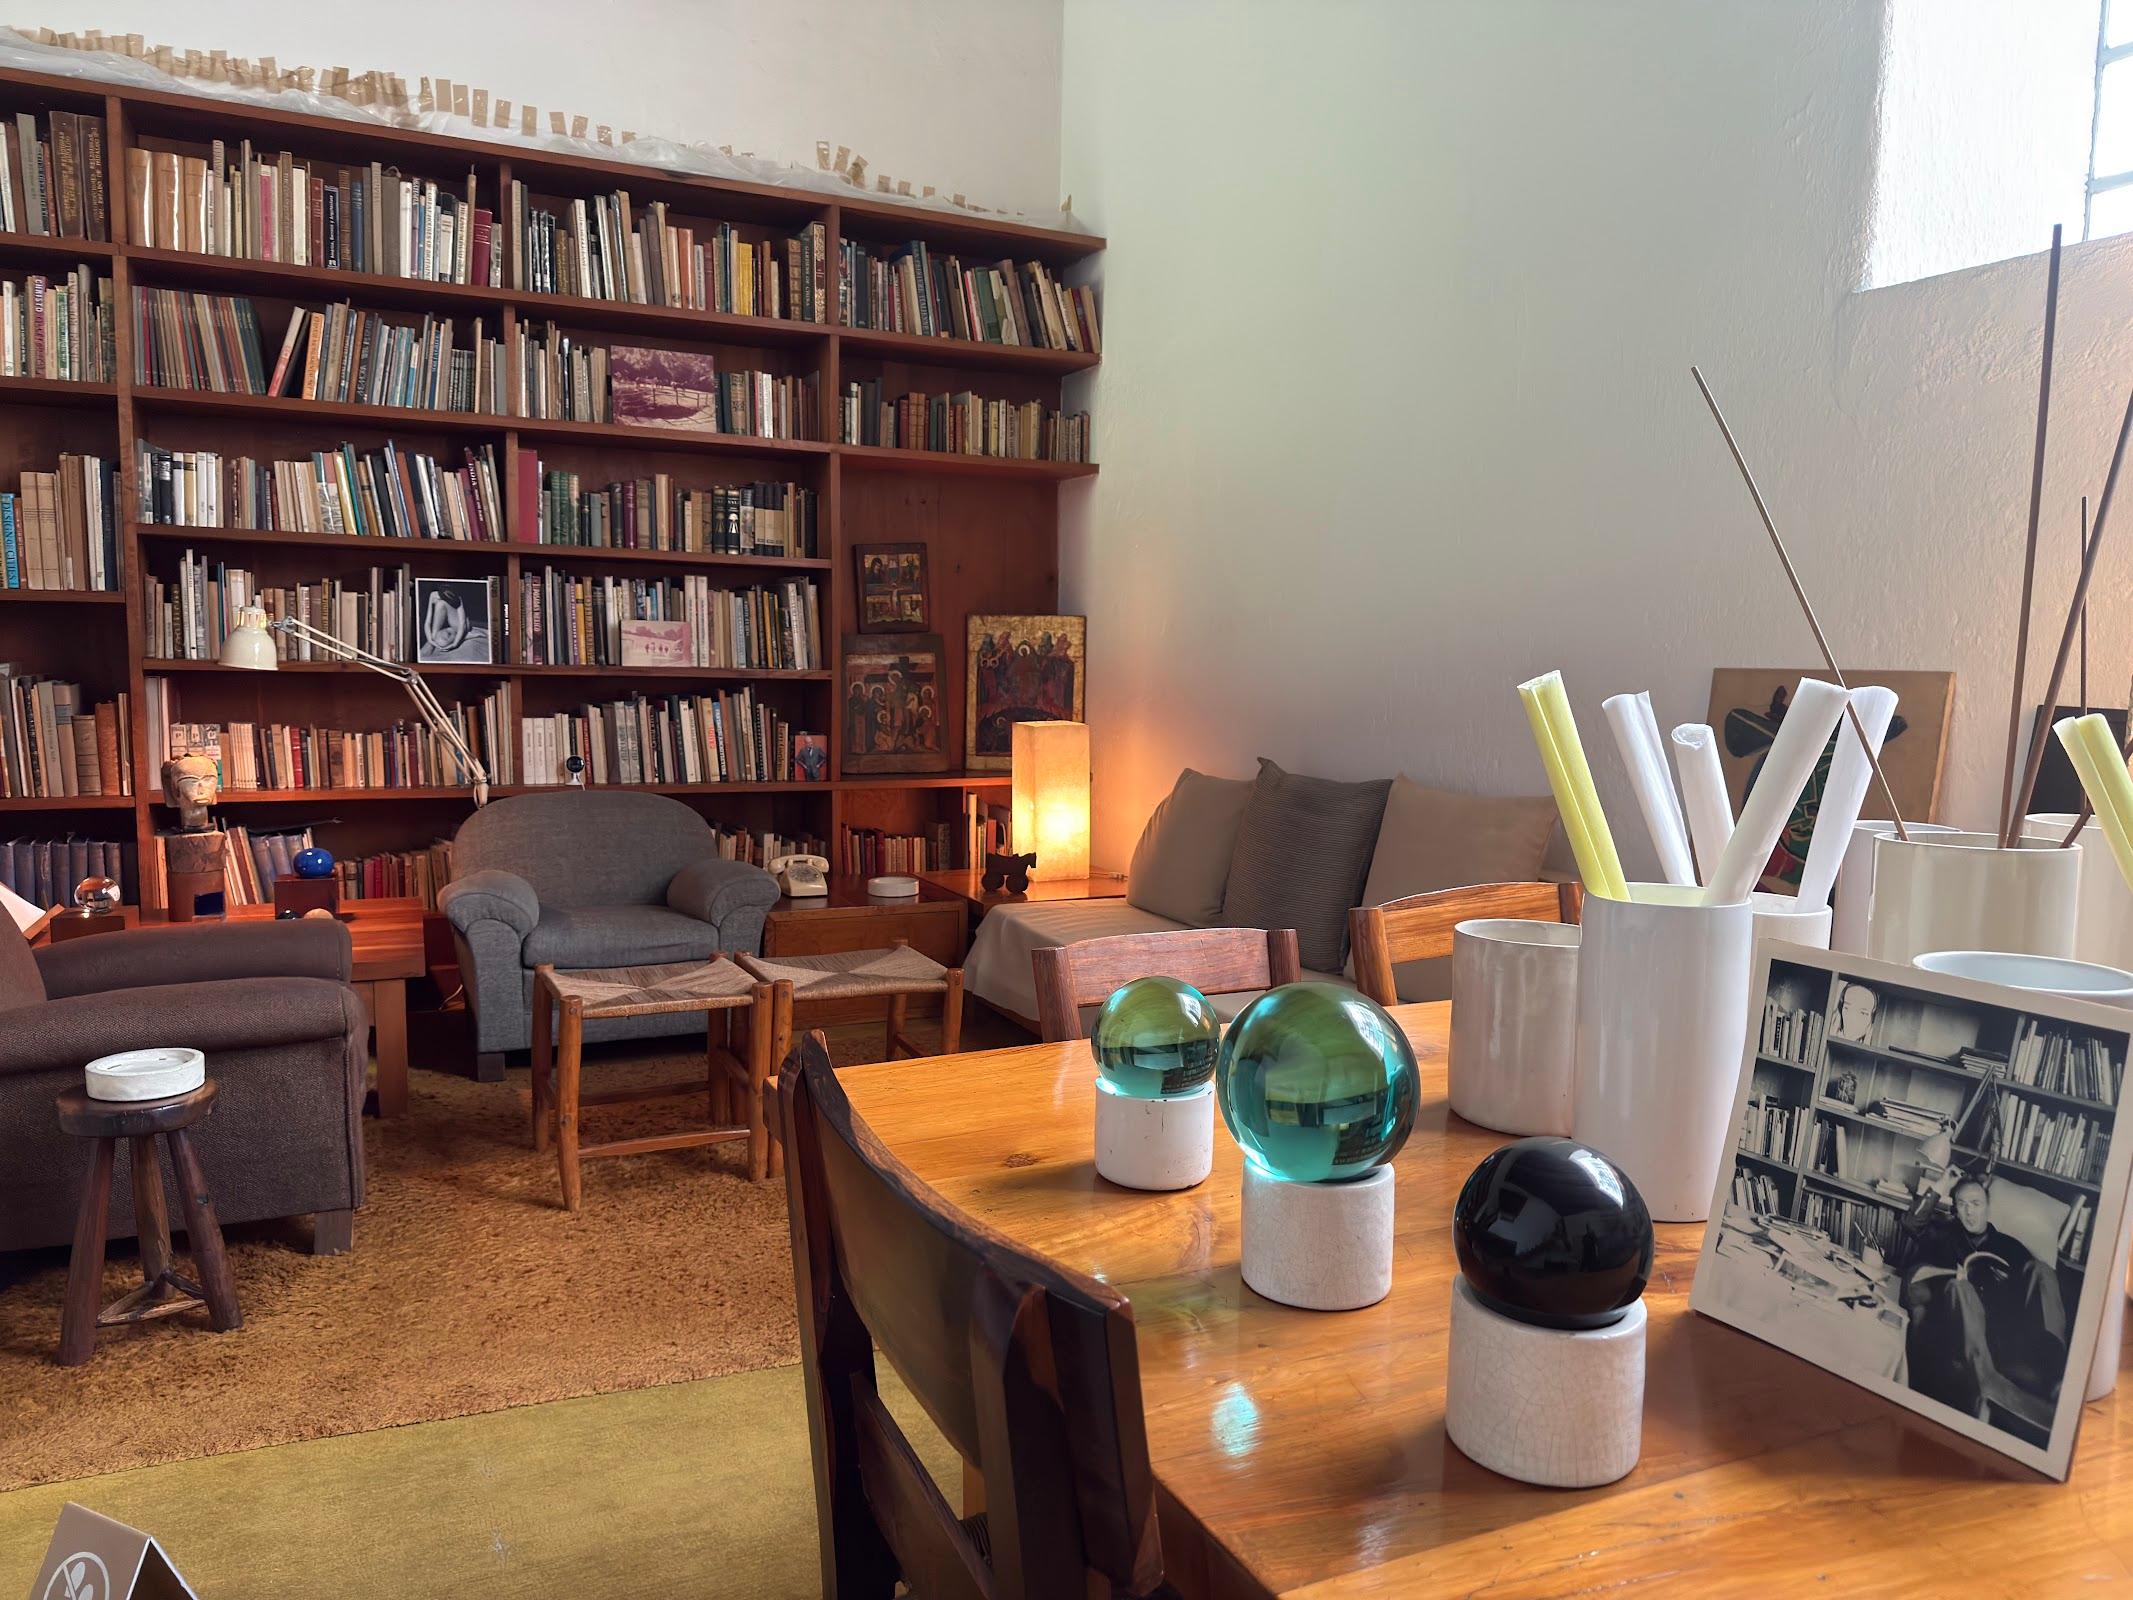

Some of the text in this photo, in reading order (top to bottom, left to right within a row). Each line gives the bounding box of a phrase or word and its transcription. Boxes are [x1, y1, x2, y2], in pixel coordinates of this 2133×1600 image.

[35, 279, 43, 312] CHRISTO
[469, 463, 477, 486] INDIA
[2, 502, 14, 538] DESIGN
[6, 551, 17, 581] CITIES
